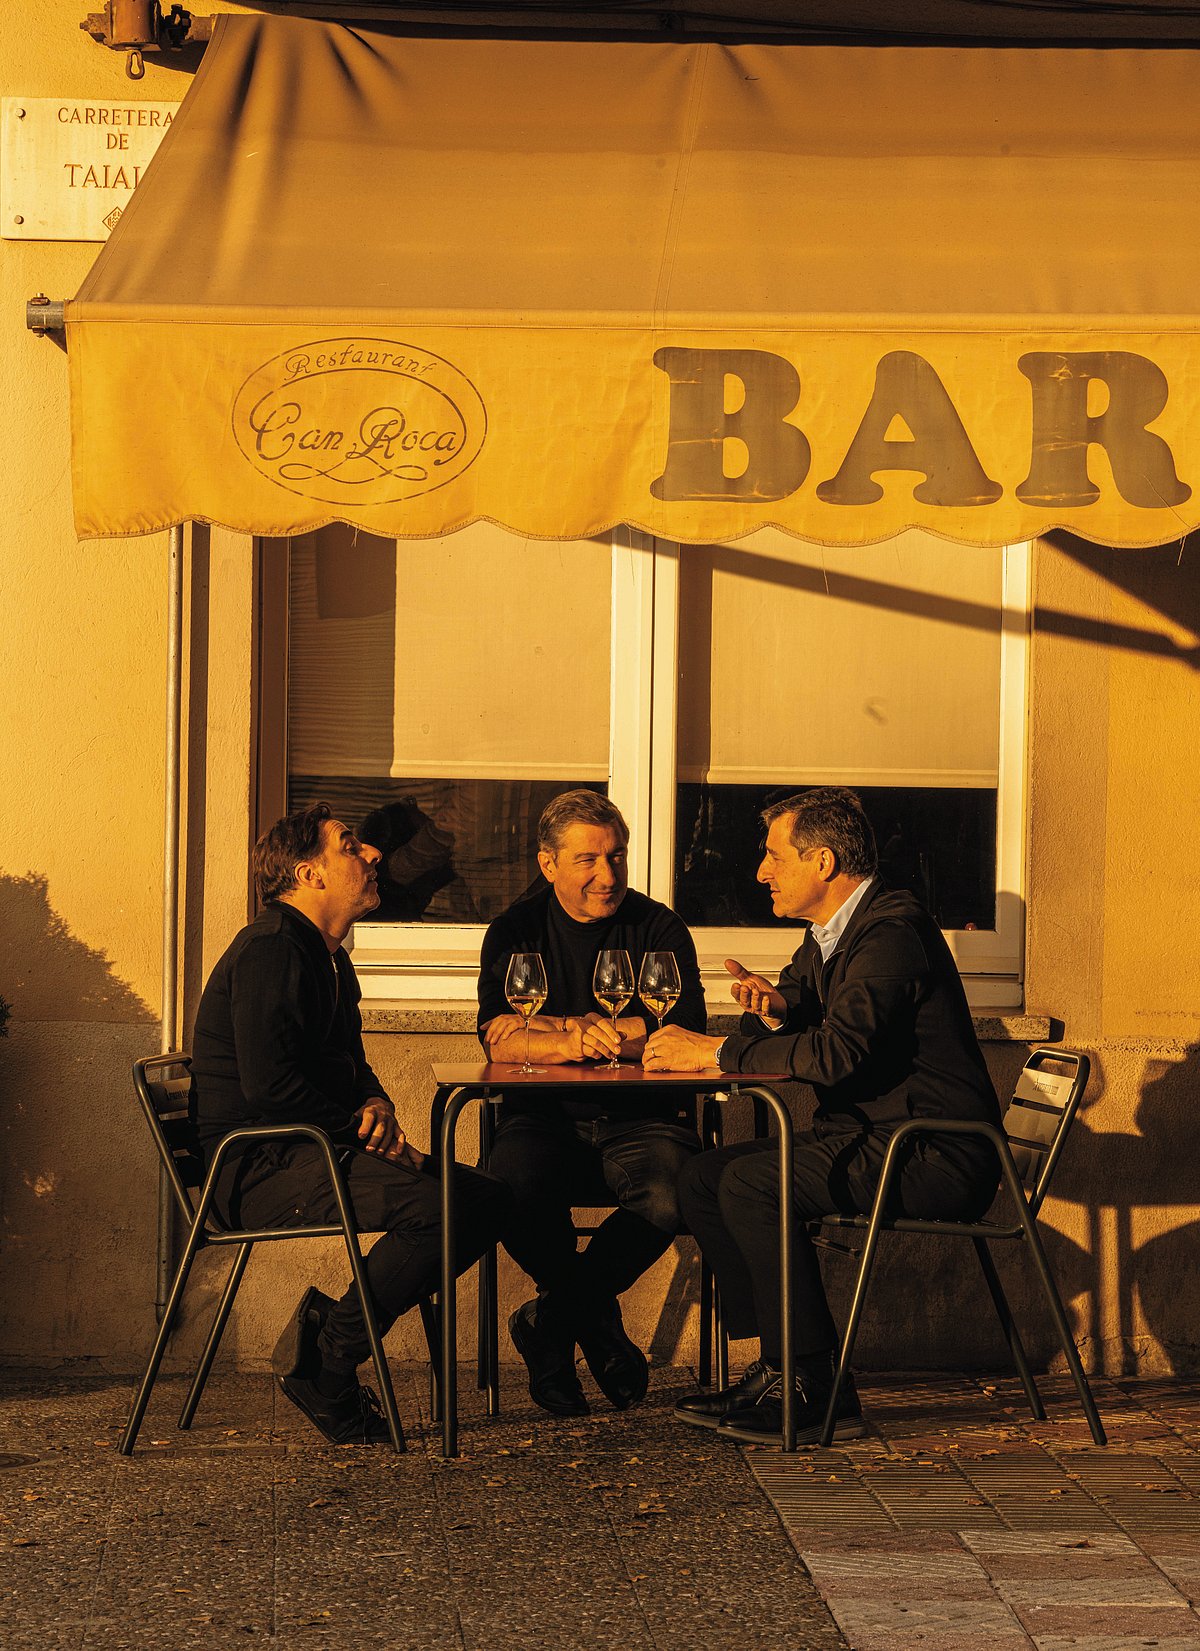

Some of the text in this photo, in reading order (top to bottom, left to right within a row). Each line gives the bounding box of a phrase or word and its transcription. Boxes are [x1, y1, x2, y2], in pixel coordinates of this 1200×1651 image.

[58, 107, 174, 127] CARRETERA
[106, 133, 129, 150] DE
[284, 344, 437, 381] Restaurant
[251, 402, 456, 461] Can Roca
[650, 346, 1192, 508] BAR
